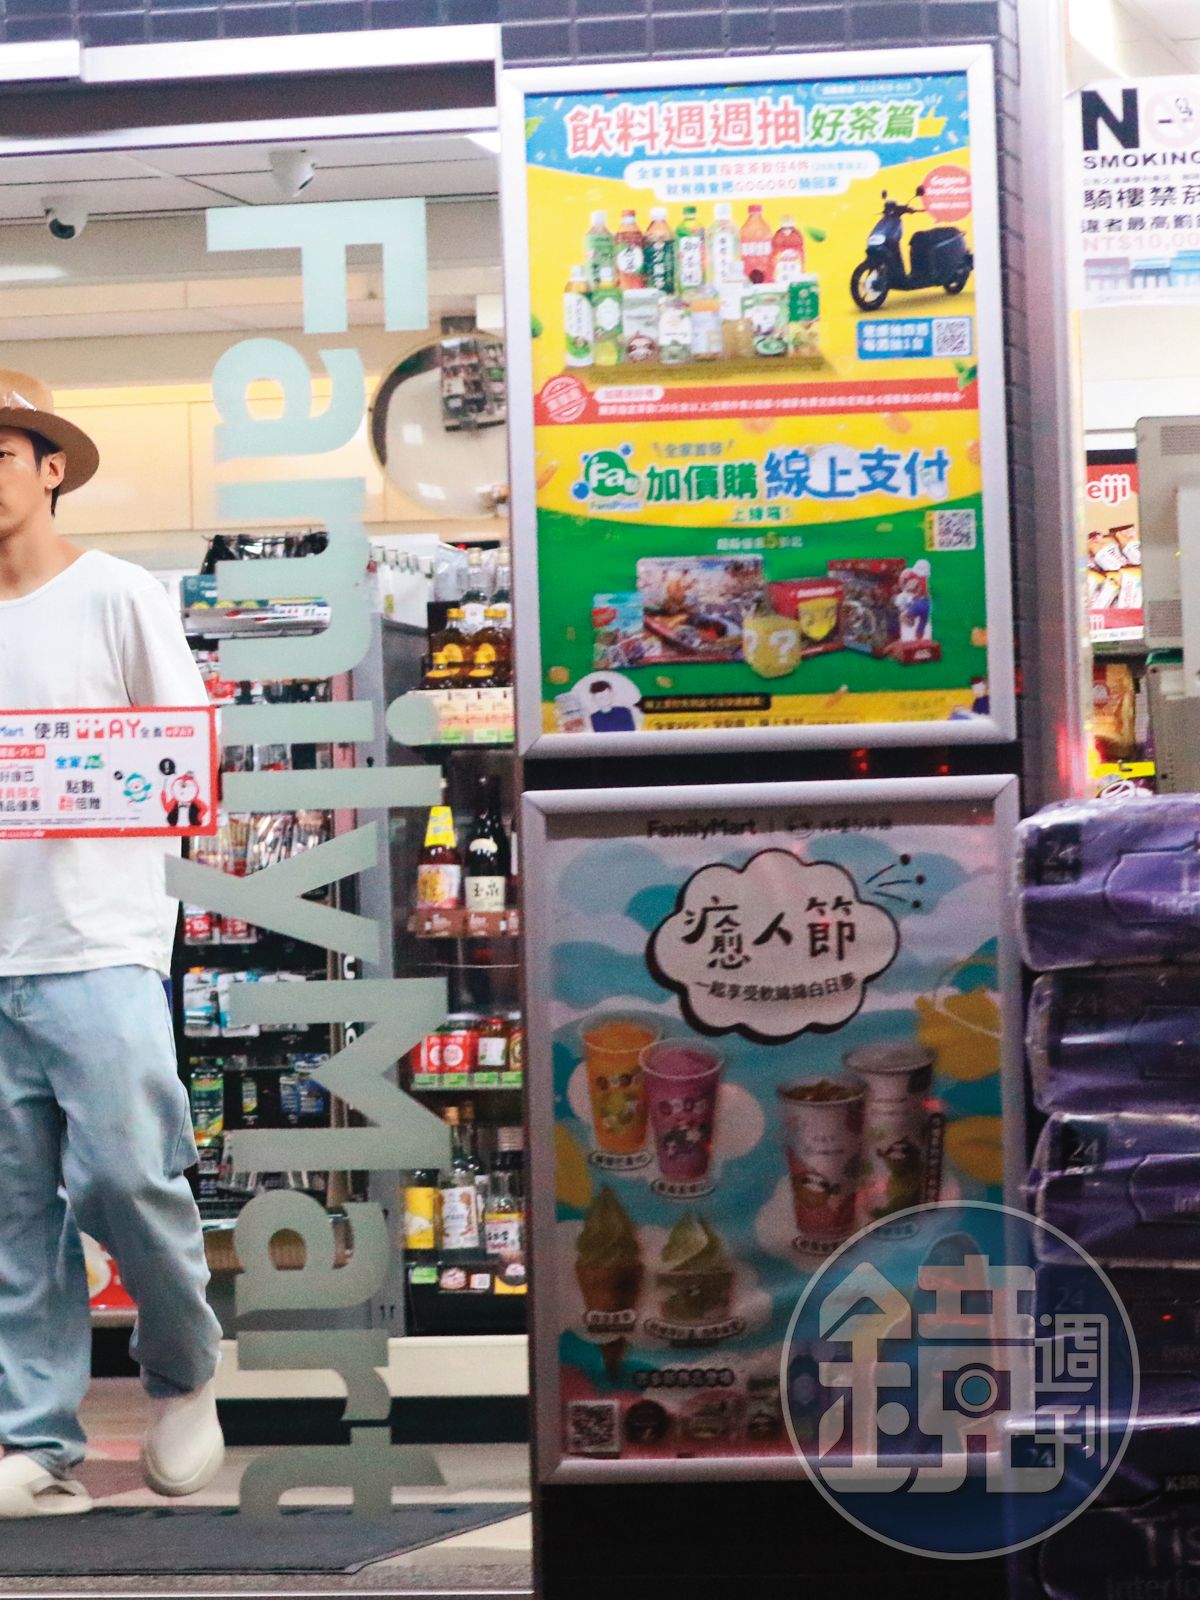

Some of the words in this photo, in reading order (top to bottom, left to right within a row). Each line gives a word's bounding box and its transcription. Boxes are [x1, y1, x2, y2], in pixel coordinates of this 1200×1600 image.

[567, 97, 803, 156] 飲料週週抽
[809, 101, 920, 145] 好茶篇
[645, 461, 759, 501] 加價購
[765, 447, 951, 499] 線上支付
[1087, 475, 1130, 503] eiji
[34, 722, 70, 740] 使用
[648, 818, 756, 839] FamilyMart
[164, 197, 451, 1521] FamilyMart
[682, 896, 858, 970] 癒人節
